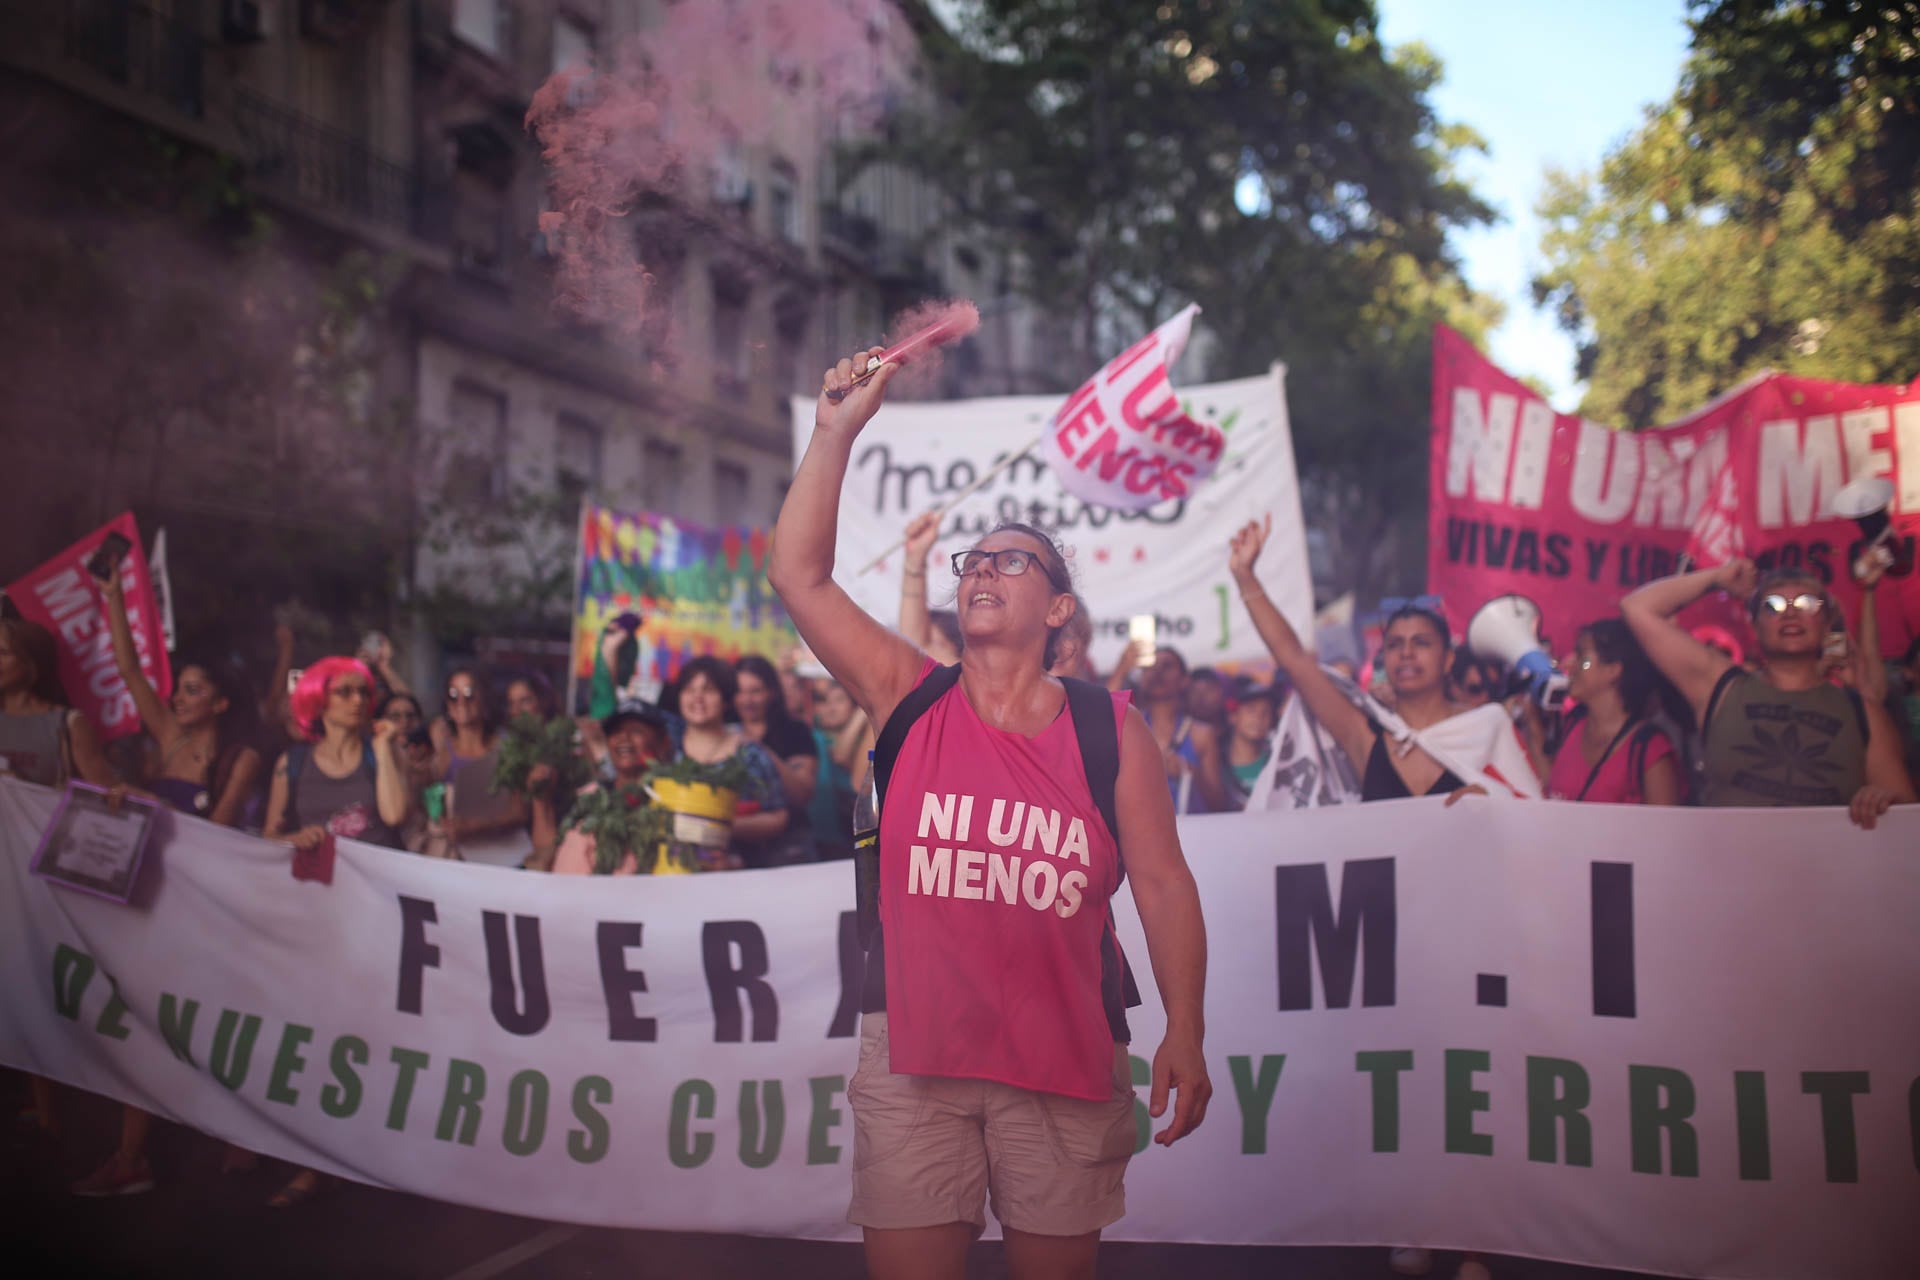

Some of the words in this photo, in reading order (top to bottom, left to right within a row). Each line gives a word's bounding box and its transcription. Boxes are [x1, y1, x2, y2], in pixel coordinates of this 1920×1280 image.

[1446, 386, 1556, 510] NI
[1447, 516, 1571, 578] VIVAS
[1584, 538, 1611, 582] Y
[917, 791, 974, 841] NI
[987, 798, 1090, 867] UNA
[908, 845, 1088, 918] MENOS
[157, 992, 613, 1165] NUESTROS
[1227, 1053, 1287, 1155] Y
[1356, 1048, 1920, 1183] TERRIT
